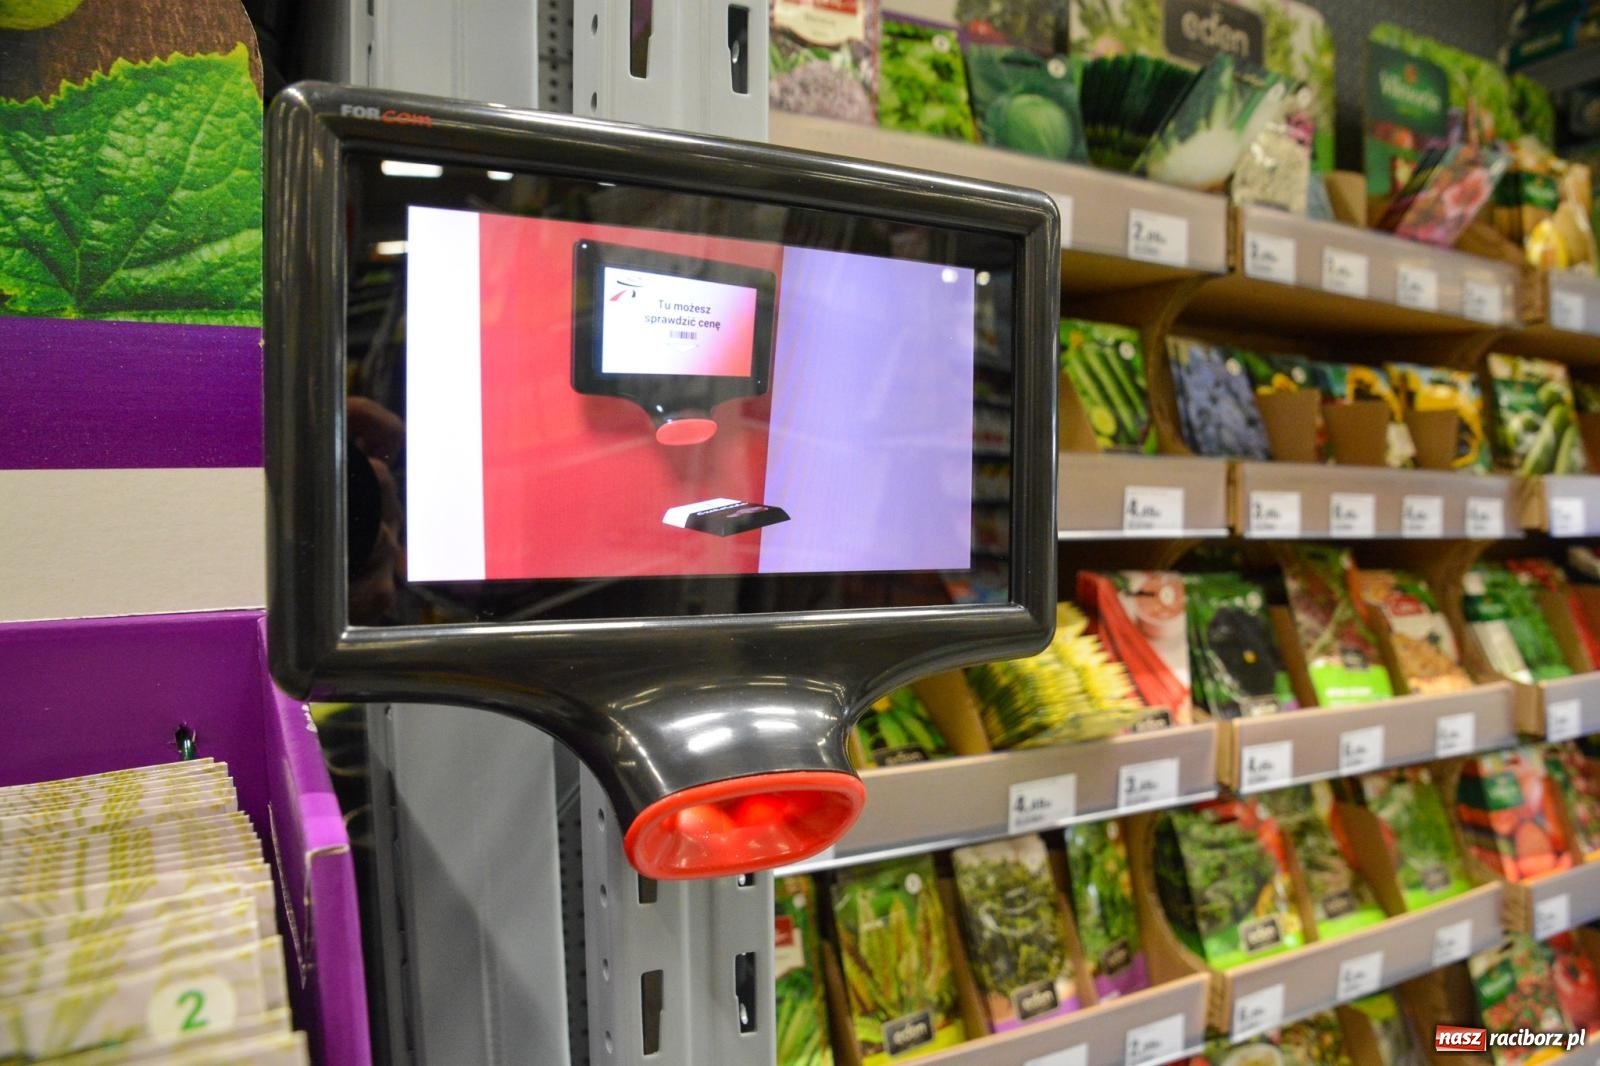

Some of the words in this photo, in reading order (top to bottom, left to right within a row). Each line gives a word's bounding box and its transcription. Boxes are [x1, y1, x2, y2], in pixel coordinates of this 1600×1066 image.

[658, 299, 671, 310] Tu
[673, 302, 711, 315] możesz
[644, 315, 696, 327] sprawdzić
[698, 319, 721, 331] cenę
[176, 989, 208, 1031] 2
